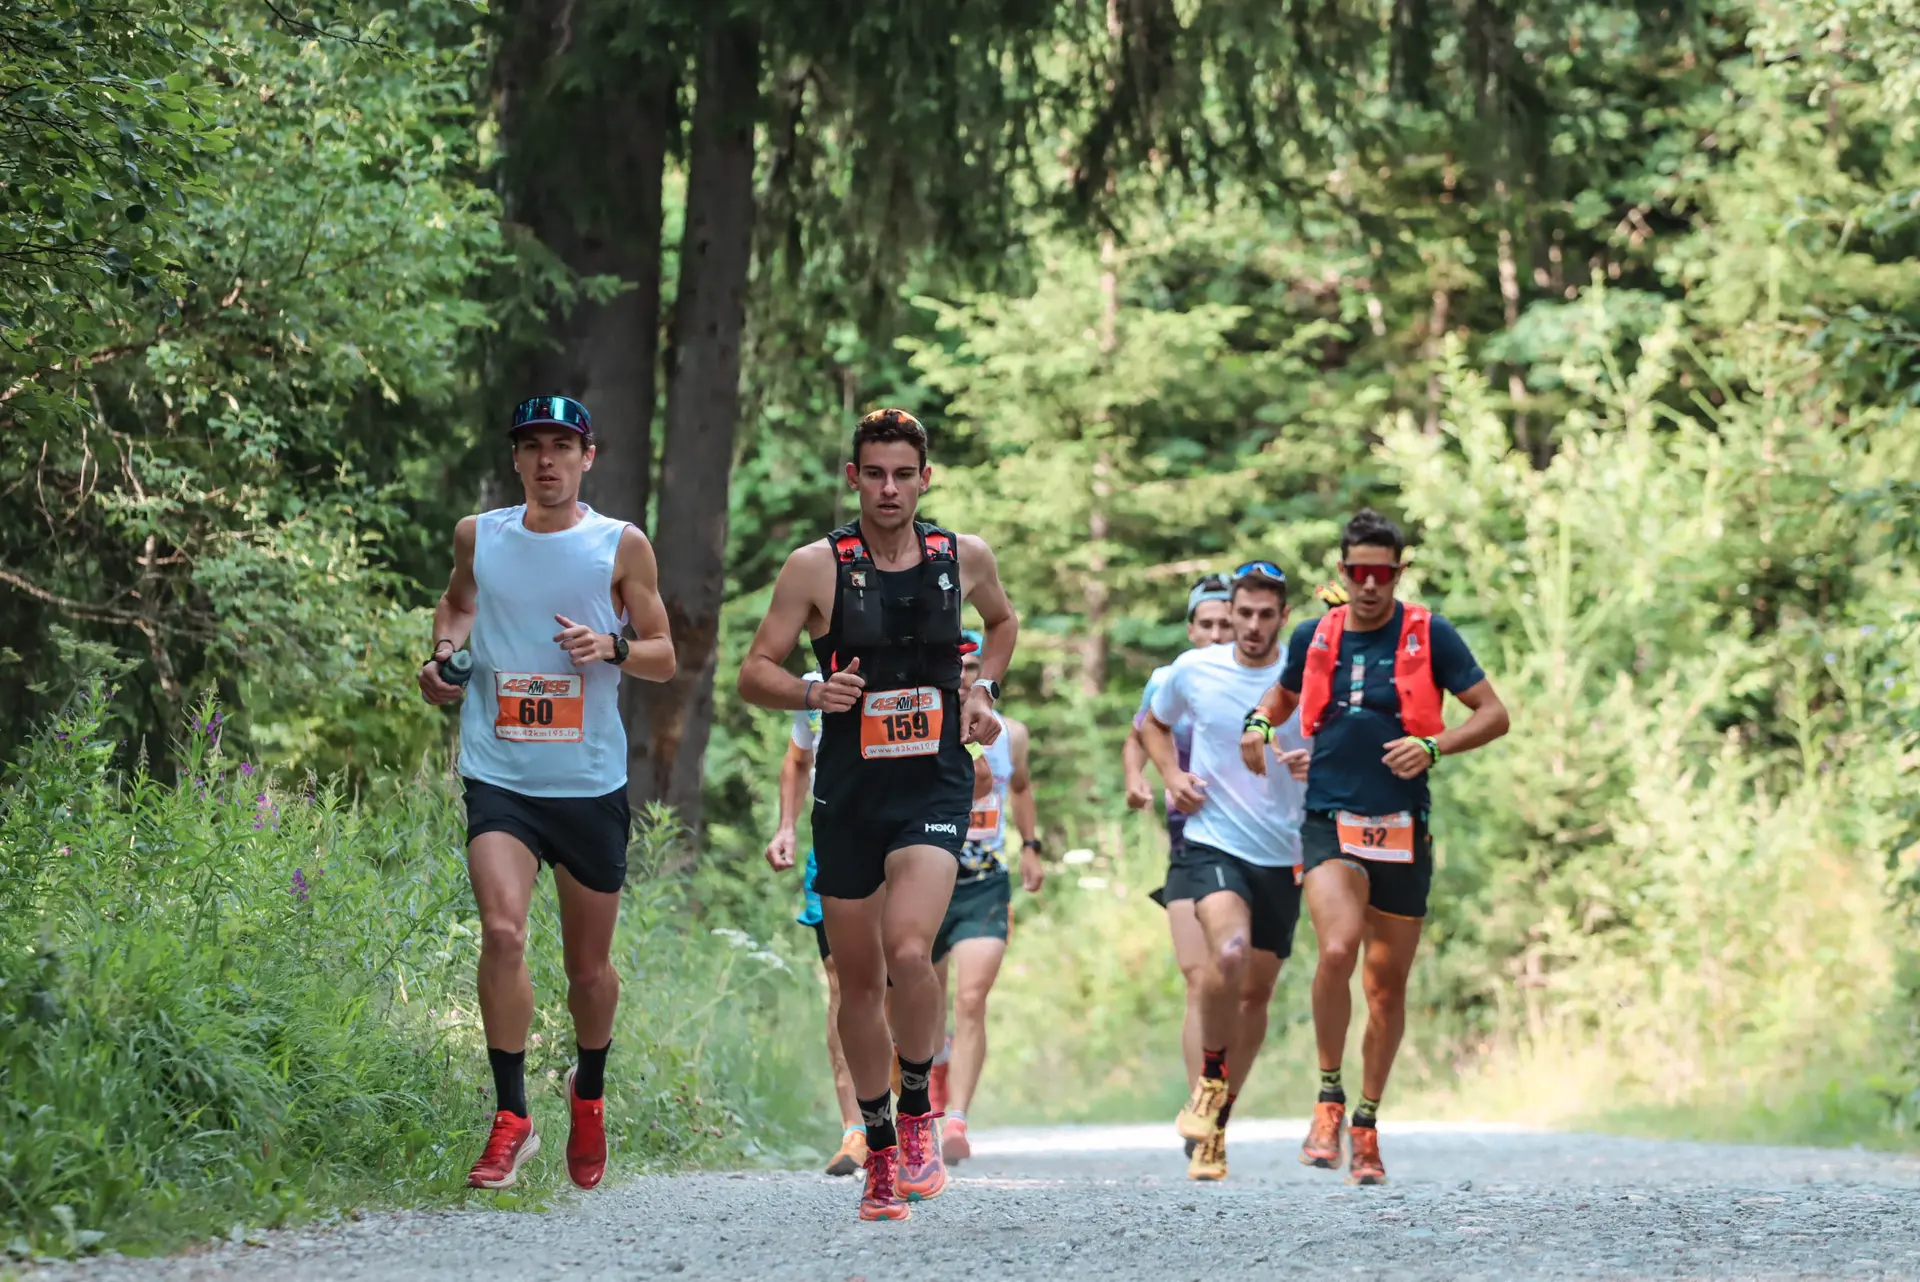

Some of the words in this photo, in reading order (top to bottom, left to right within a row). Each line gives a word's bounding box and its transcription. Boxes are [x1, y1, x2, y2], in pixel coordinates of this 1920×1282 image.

[519, 698, 553, 725] 60
[882, 712, 929, 742] 159
[925, 823, 957, 836] HOKA
[1363, 828, 1388, 847] 52
